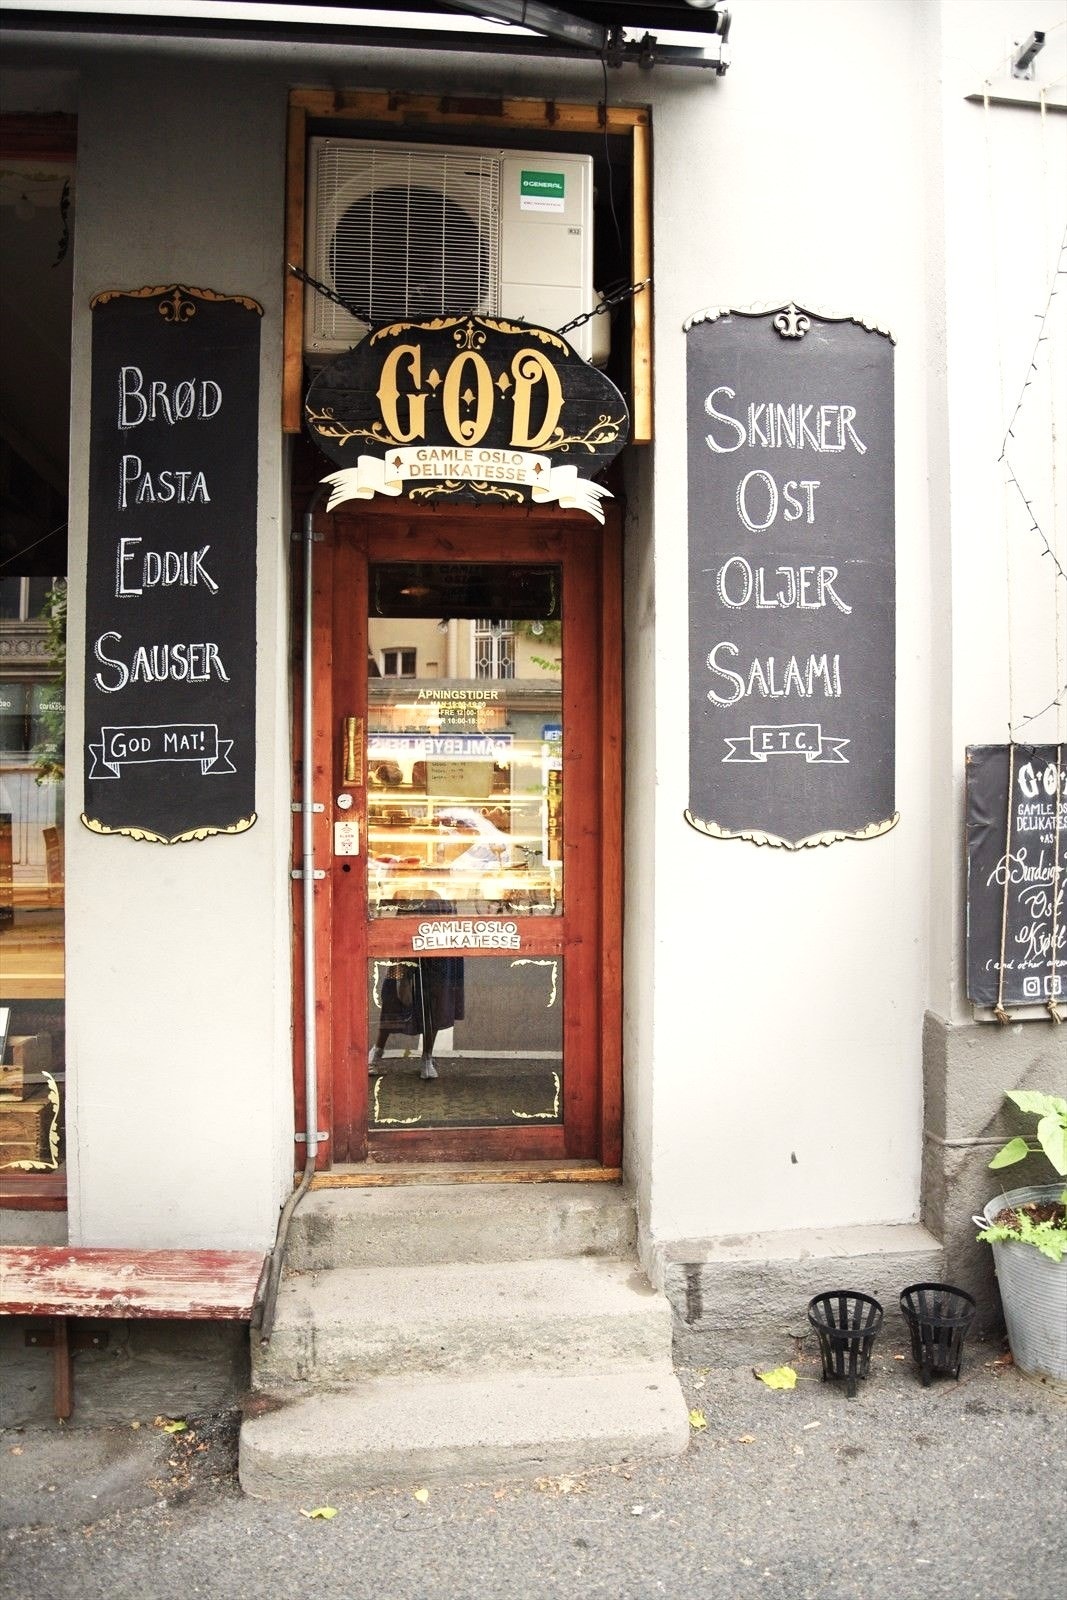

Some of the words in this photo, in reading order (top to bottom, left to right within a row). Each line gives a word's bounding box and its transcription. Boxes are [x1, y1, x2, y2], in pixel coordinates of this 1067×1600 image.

[416, 449, 473, 463] GAMLE
[479, 450, 523, 466] OSLO
[409, 464, 527, 482] DELIKATESSE
[1018, 803, 1054, 816] GAMLE
[420, 922, 471, 935] GAMLE
[475, 922, 516, 934] OSLO
[413, 935, 520, 949] DELIKATESSE
